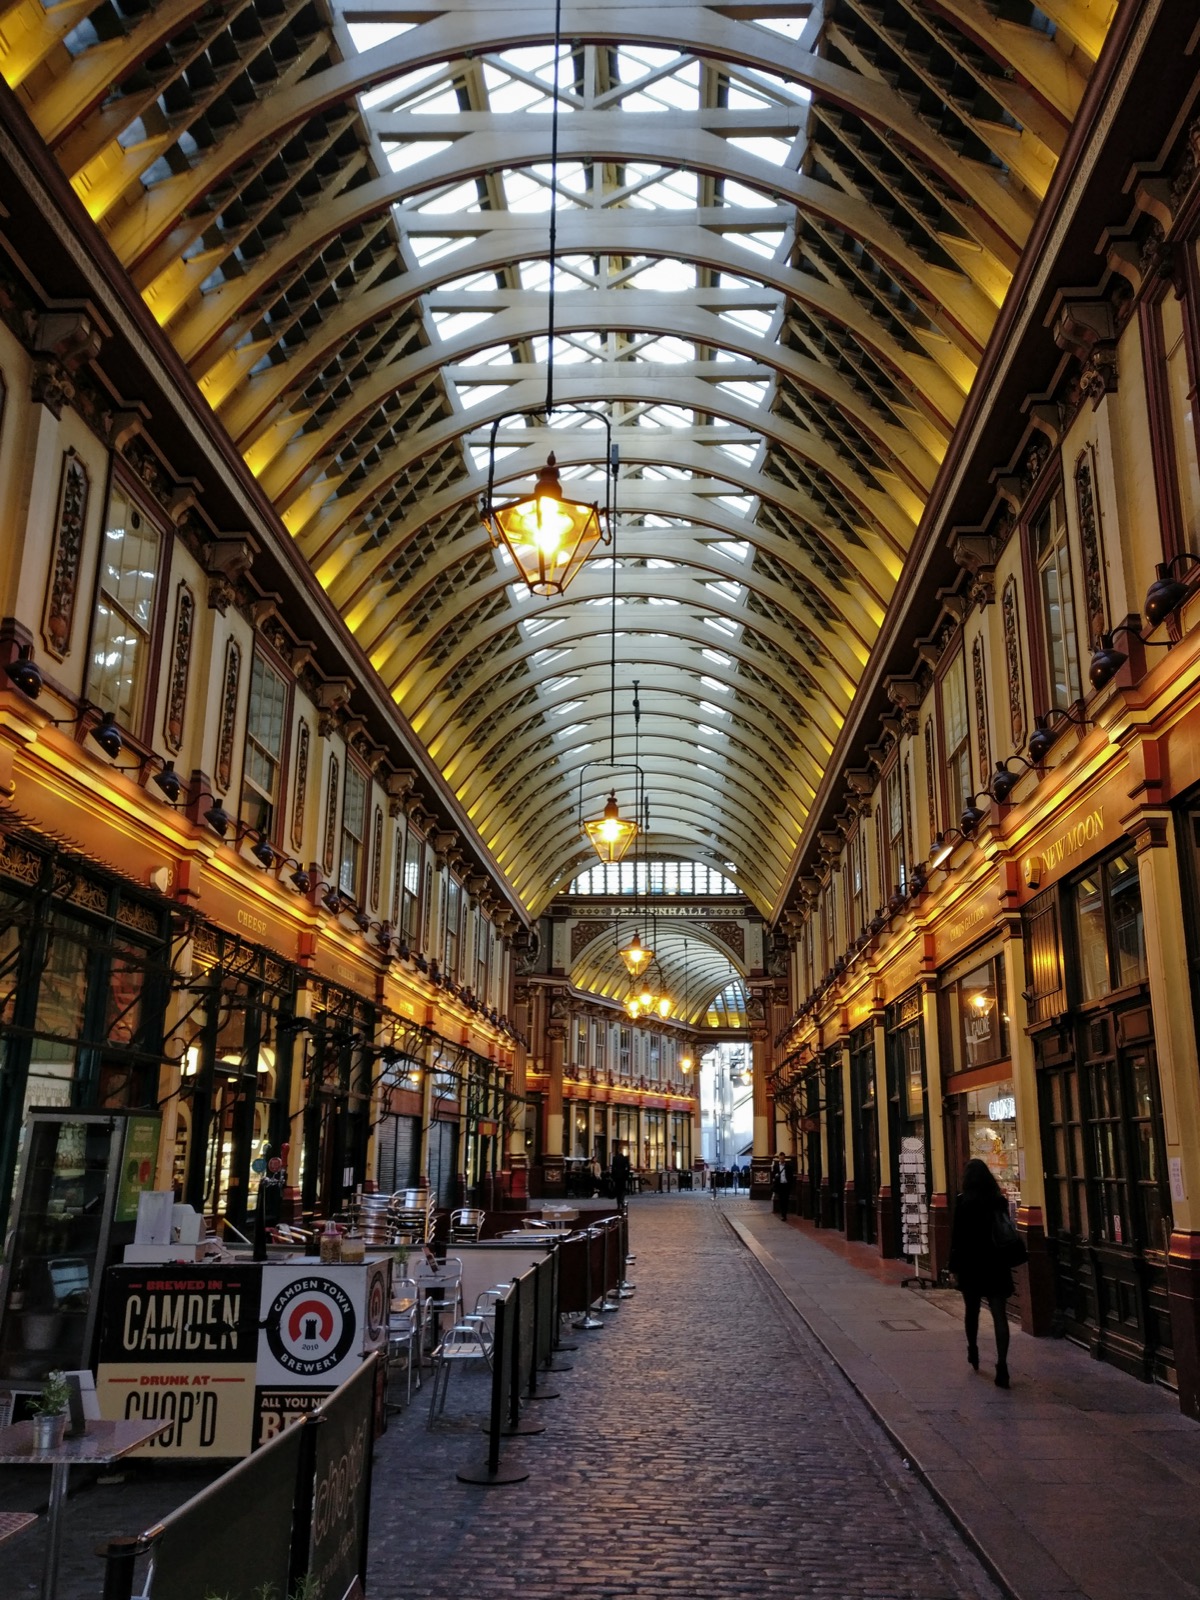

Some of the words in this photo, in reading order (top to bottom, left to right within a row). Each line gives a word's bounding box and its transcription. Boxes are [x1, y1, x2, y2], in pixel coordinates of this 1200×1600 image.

[1041, 835, 1066, 876] NEW
[1067, 805, 1104, 856] MOON
[610, 907, 707, 916] LEADENHALL
[237, 909, 267, 937] CHEESE
[146, 1280, 205, 1291] BREWED
[207, 1280, 223, 1291] IN
[274, 1280, 319, 1312] CAMDEN
[322, 1282, 351, 1313] TOWN
[123, 1294, 240, 1351] CAMDEN
[301, 1342, 319, 1351] 2010
[280, 1353, 338, 1372] BREWERY
[140, 1375, 190, 1386] DRUNK
[191, 1375, 211, 1386] AT
[261, 1397, 281, 1408] ALL
[284, 1397, 308, 1408] YOU
